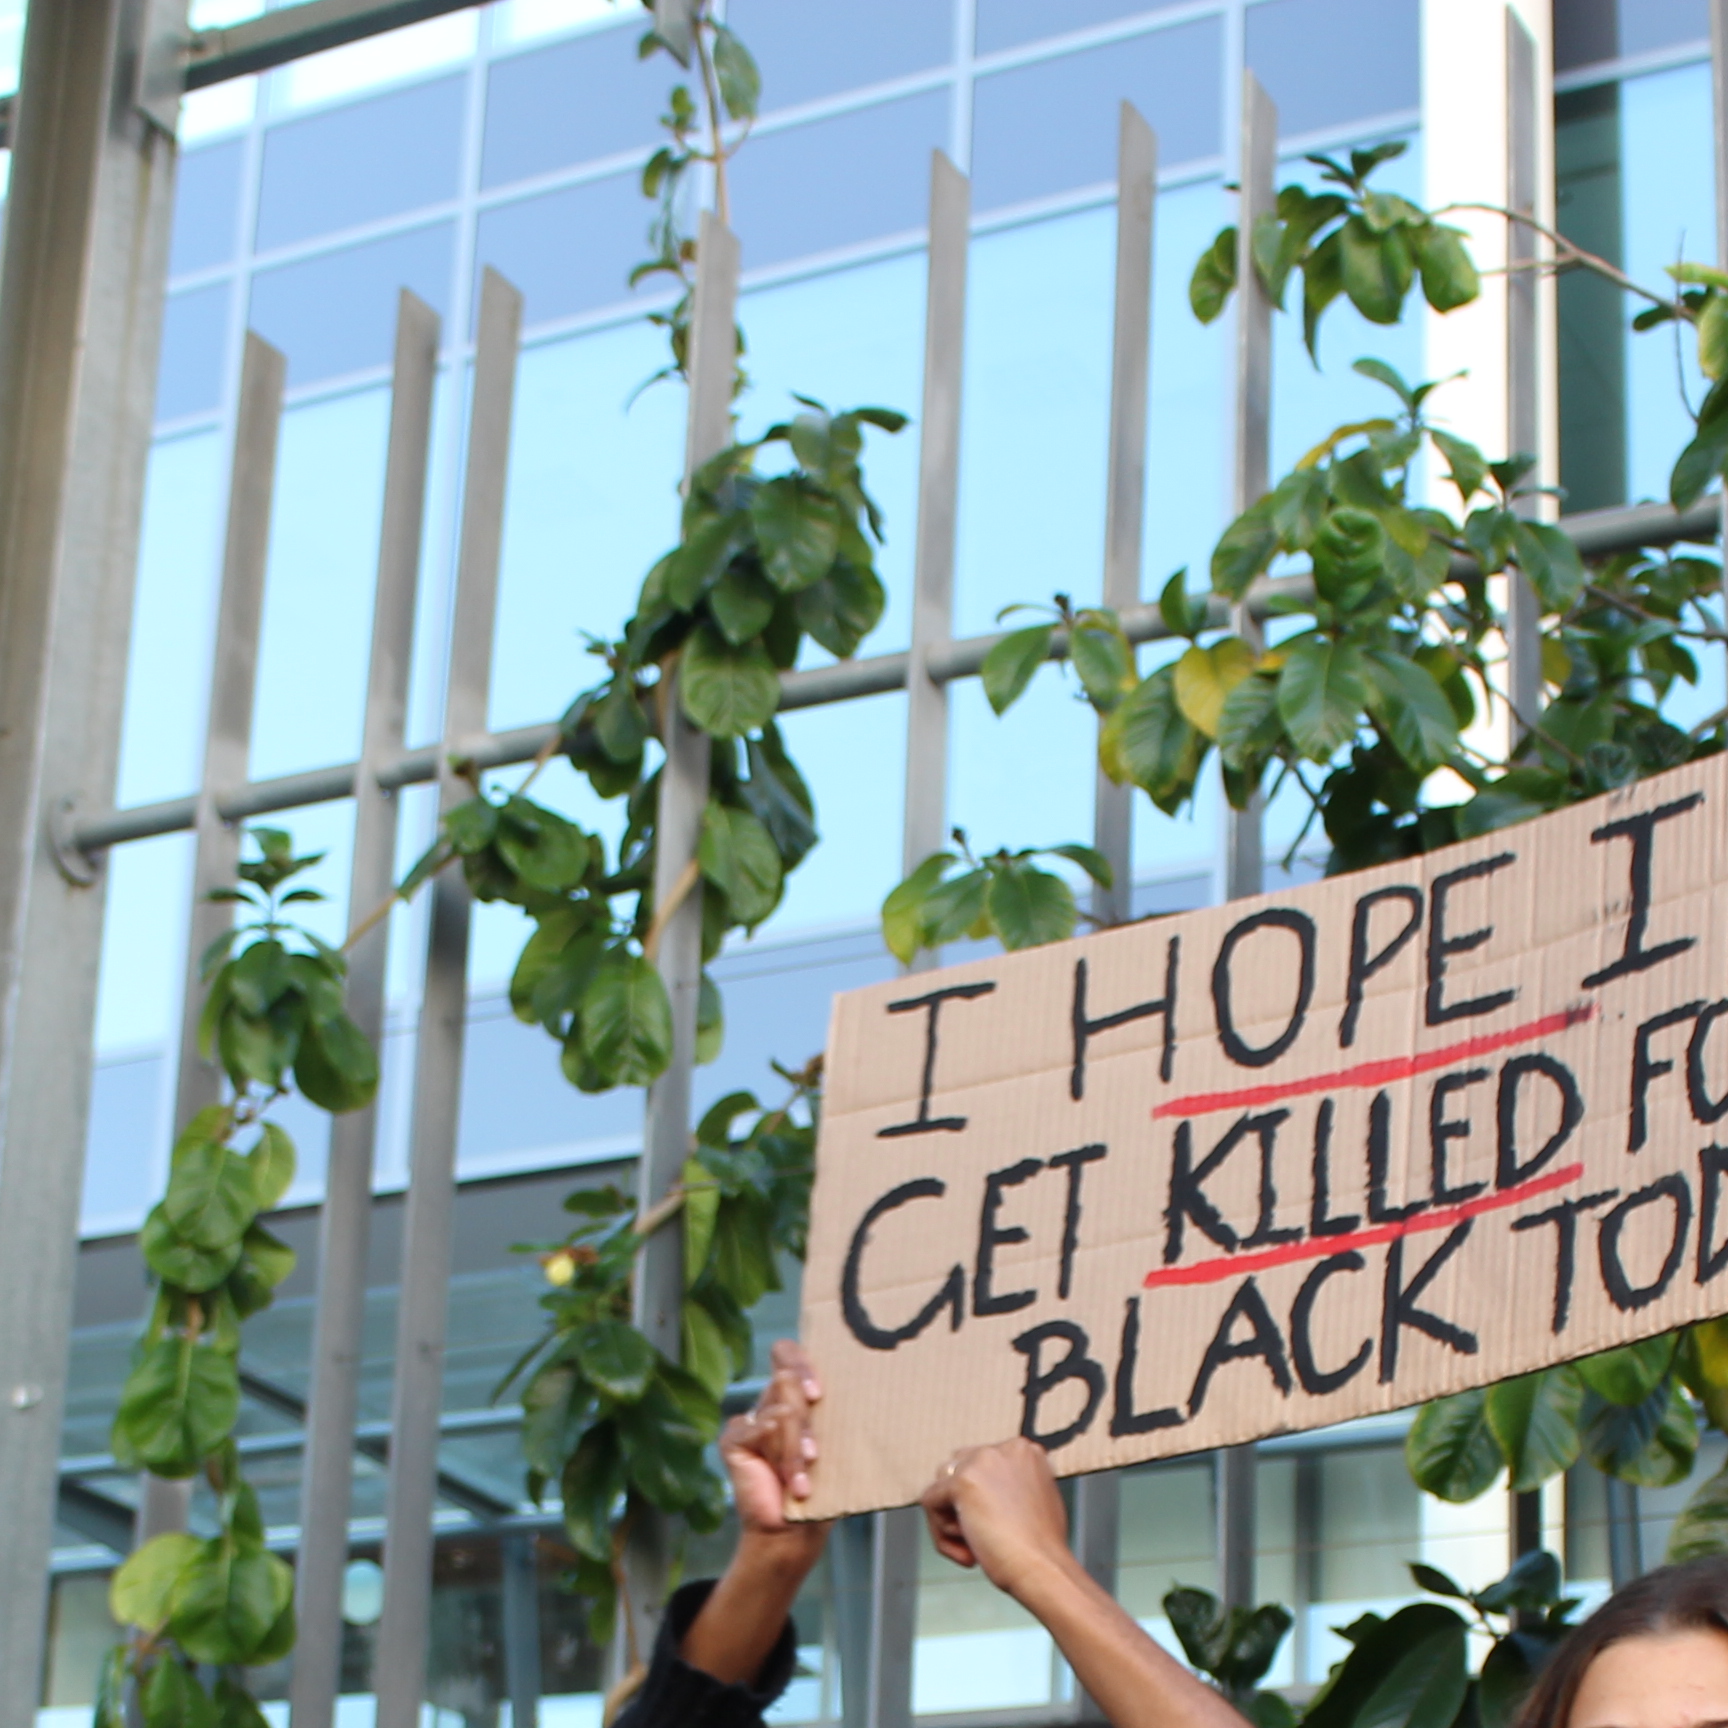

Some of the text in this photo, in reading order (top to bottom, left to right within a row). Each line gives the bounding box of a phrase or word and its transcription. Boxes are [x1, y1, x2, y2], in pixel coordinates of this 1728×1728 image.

[875, 981, 997, 1138] I
[1069, 851, 1521, 1102] HOPE
[1581, 790, 1706, 989] I
[840, 1143, 1108, 1351] GET
[1163, 1051, 1586, 1266] KILLED
[1011, 1216, 1479, 1450] BLACK
